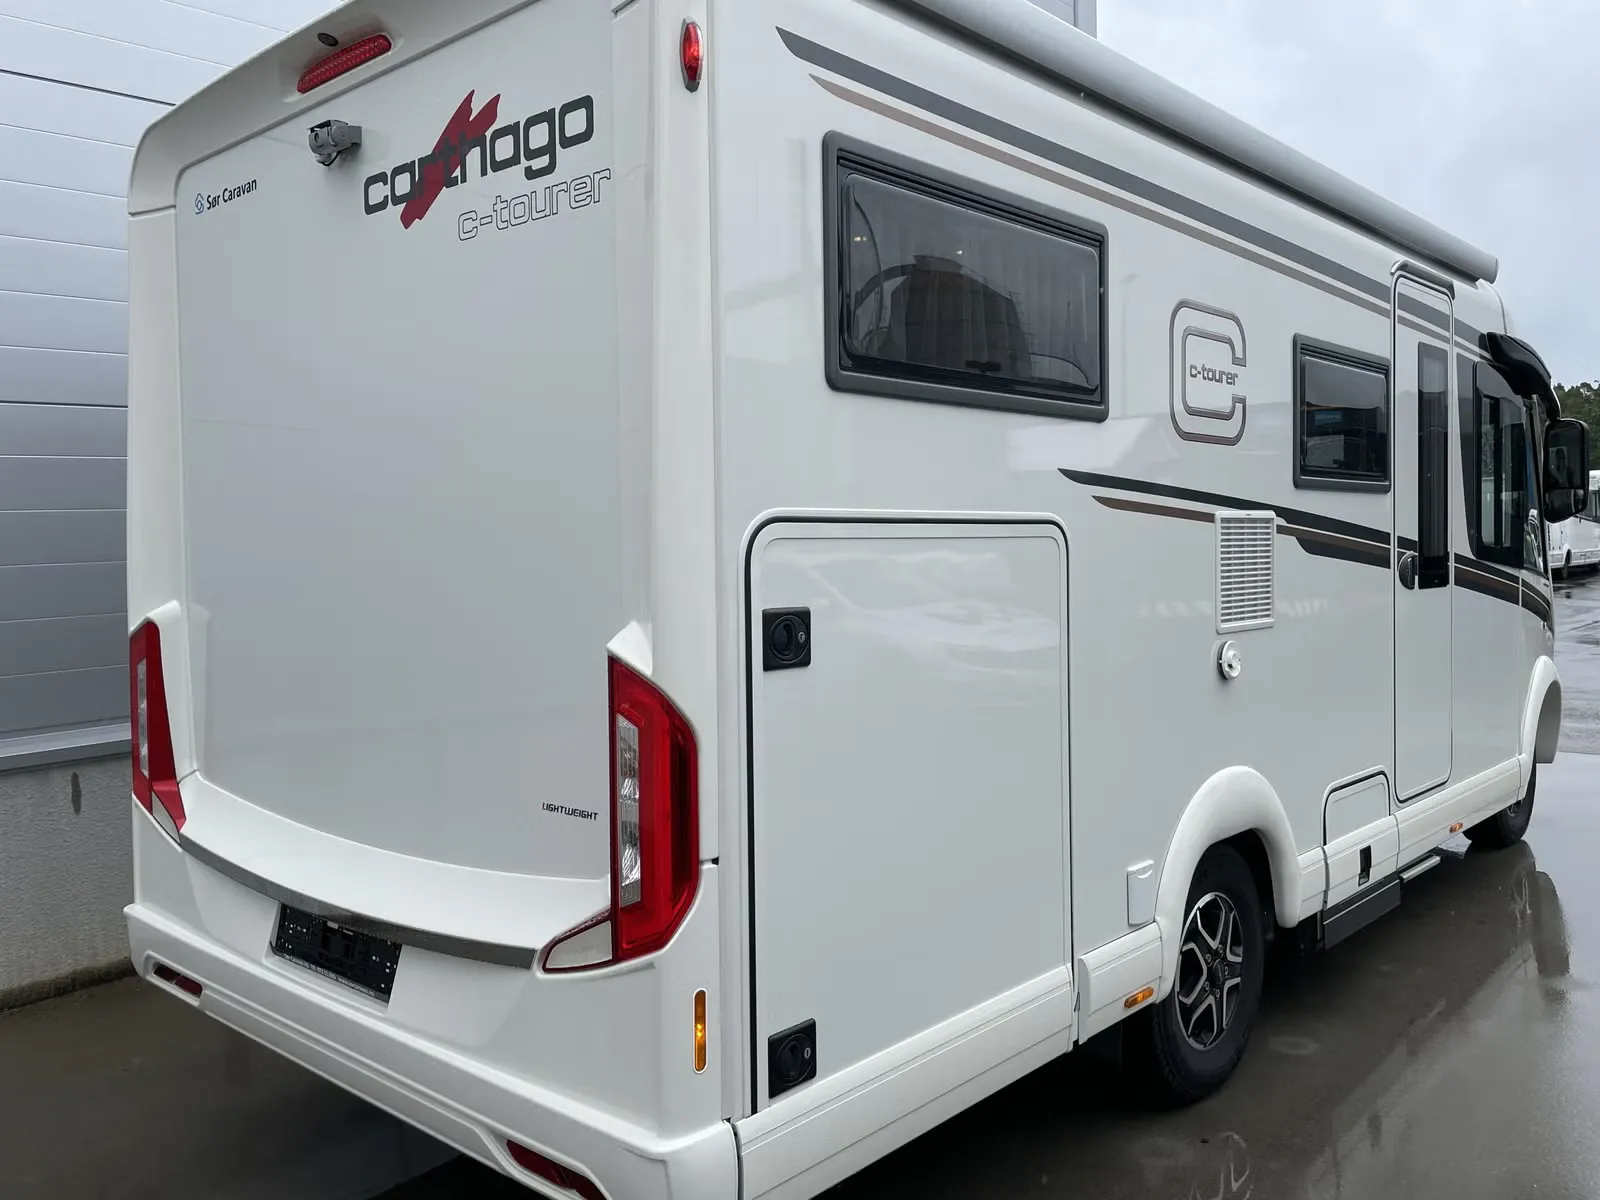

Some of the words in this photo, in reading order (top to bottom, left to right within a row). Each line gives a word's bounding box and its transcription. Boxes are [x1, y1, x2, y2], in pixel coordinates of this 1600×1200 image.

[363, 94, 595, 216] carthago
[206, 194, 221, 210] Sør
[222, 178, 257, 203] Caravan
[457, 167, 612, 242] c-tourer
[1189, 363, 1239, 386] c-tourer
[541, 801, 599, 822] LIGHTWEIGHT
